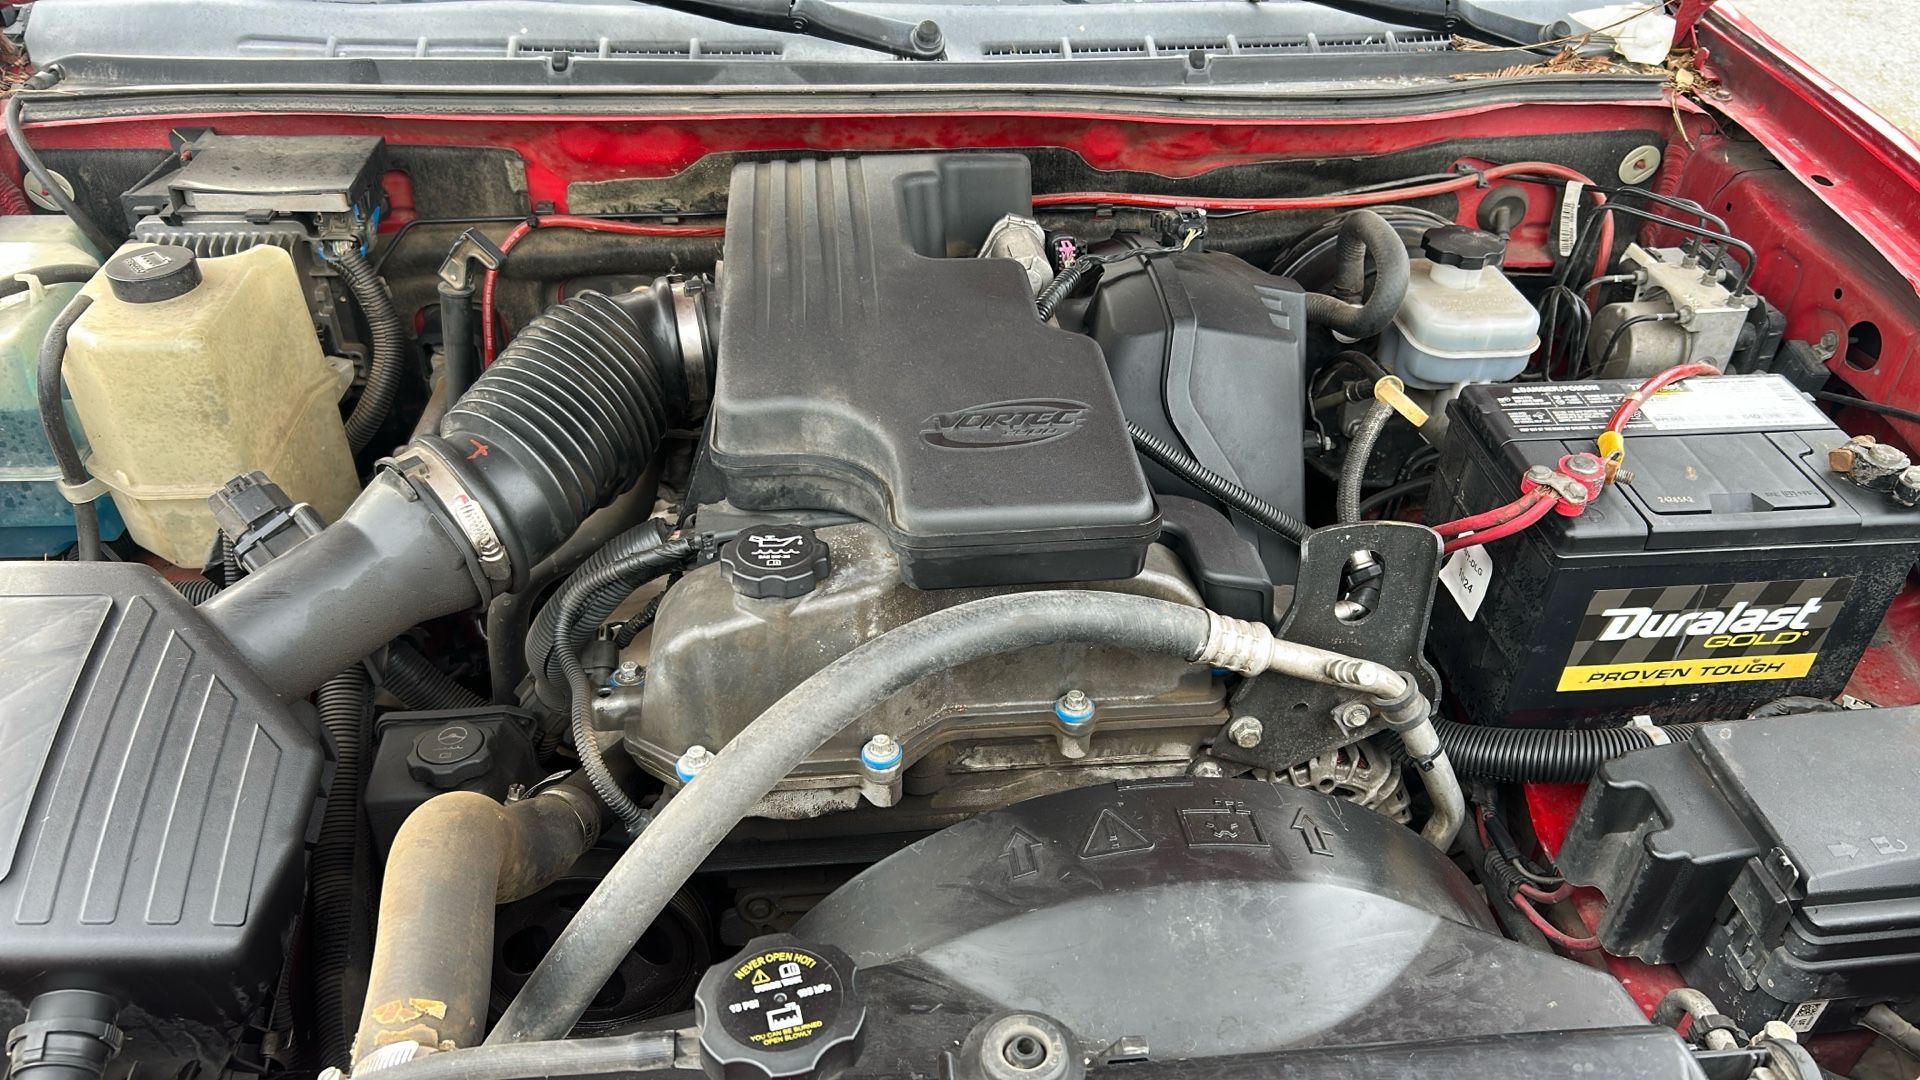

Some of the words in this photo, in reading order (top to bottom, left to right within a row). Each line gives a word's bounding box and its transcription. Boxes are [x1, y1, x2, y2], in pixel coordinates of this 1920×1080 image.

[1598, 597, 1822, 641] Duralast
[1703, 631, 1803, 649] GOLD
[1586, 667, 1692, 683] PROVEN
[1700, 662, 1785, 677] TOUGH
[734, 956, 766, 980] NEVER
[765, 952, 793, 963] OPEN
[793, 953, 817, 969] HOT!
[743, 999, 760, 1011] PSI
[750, 1032, 766, 1042] YOU
[767, 1030, 782, 1039] CAN
[783, 1027, 793, 1035] BE
[793, 1021, 823, 1032] BURNED
[763, 1036, 784, 1046] OPEN
[785, 1029, 813, 1043] SLOWLY
